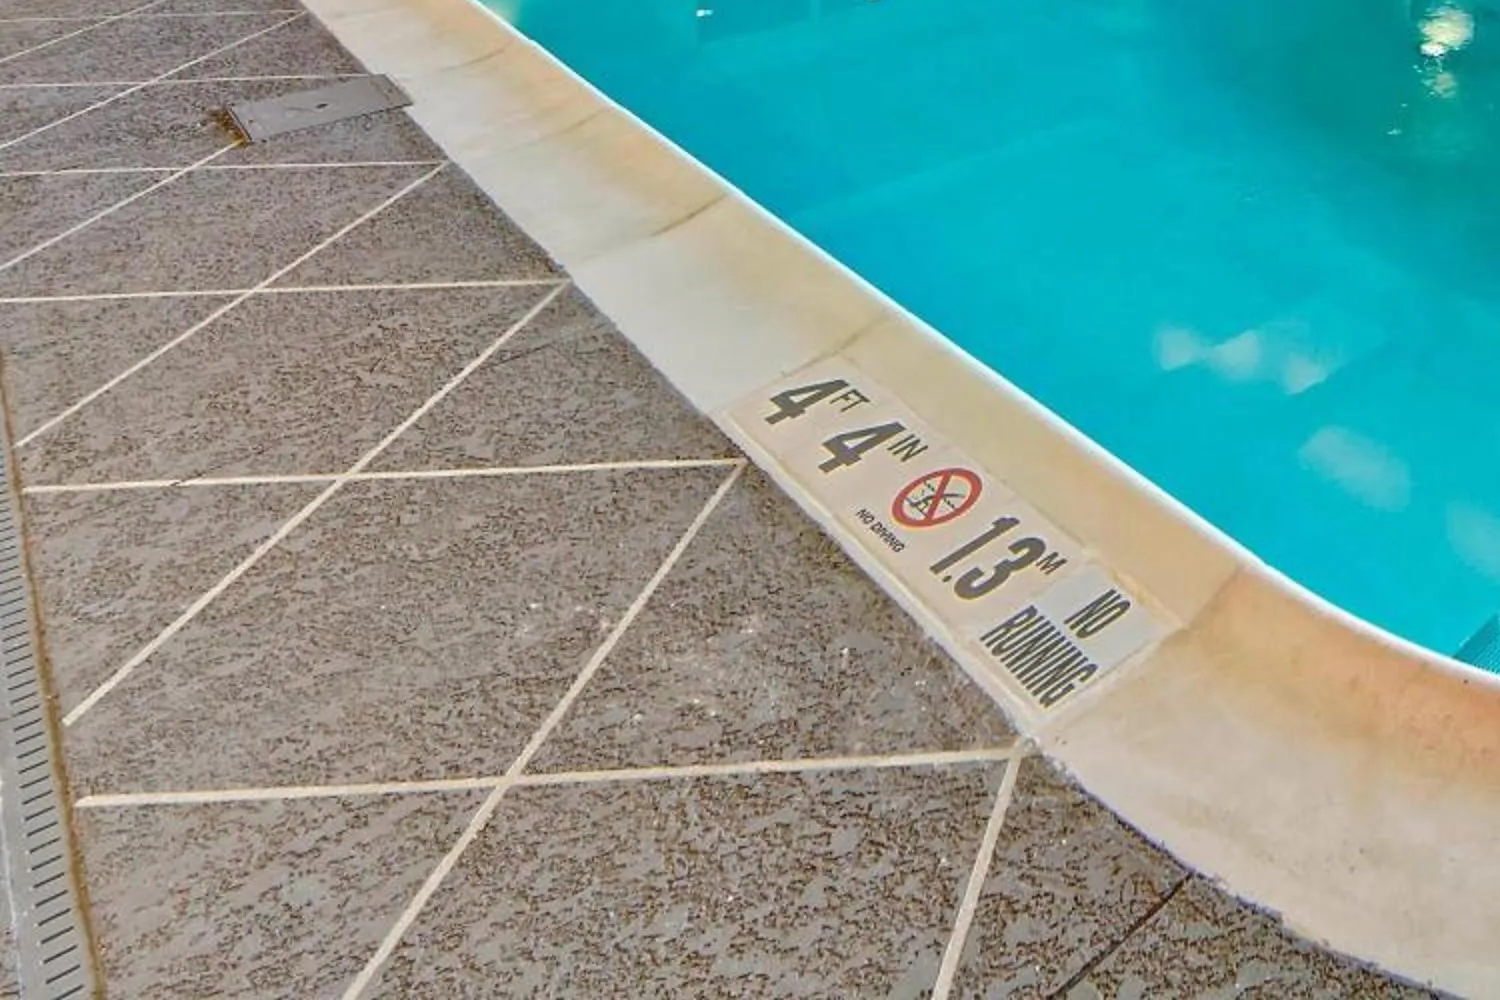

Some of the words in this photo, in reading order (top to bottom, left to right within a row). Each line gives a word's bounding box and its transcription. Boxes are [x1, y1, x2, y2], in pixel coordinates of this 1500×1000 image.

[764, 379, 848, 425] 4
[830, 390, 870, 413] FT
[817, 421, 906, 473] 4
[887, 433, 929, 464] IN
[855, 508, 875, 528] NO
[869, 520, 906, 554] DIVING
[928, 516, 1048, 601] 1.3
[1034, 551, 1067, 576] M
[1062, 588, 1132, 640] NO
[979, 604, 1101, 710] RUNNING
